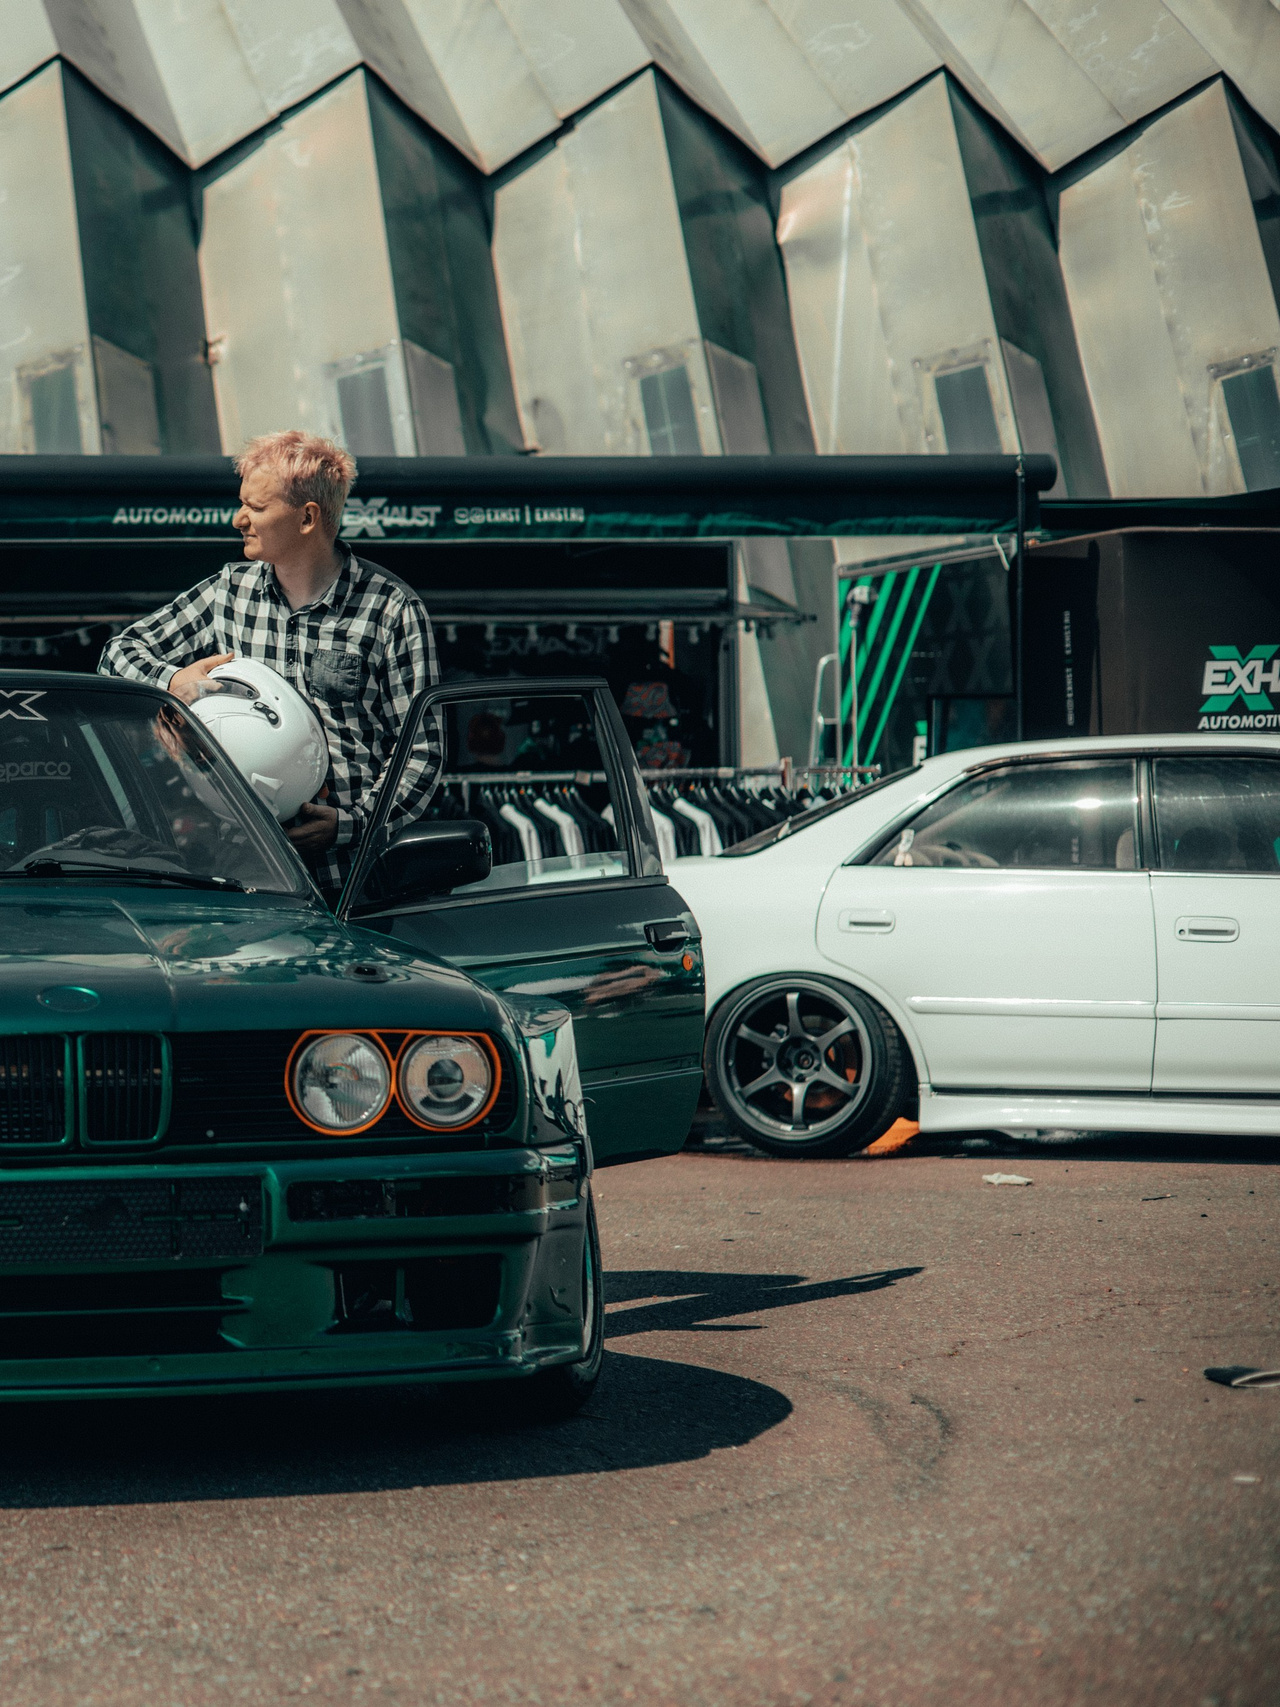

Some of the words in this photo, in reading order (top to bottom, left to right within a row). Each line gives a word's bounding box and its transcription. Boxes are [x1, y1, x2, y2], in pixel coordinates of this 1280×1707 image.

[112, 507, 239, 524] AUTOMOTIV
[340, 497, 442, 537] EXHAUST
[1202, 660, 1280, 695] EXH
